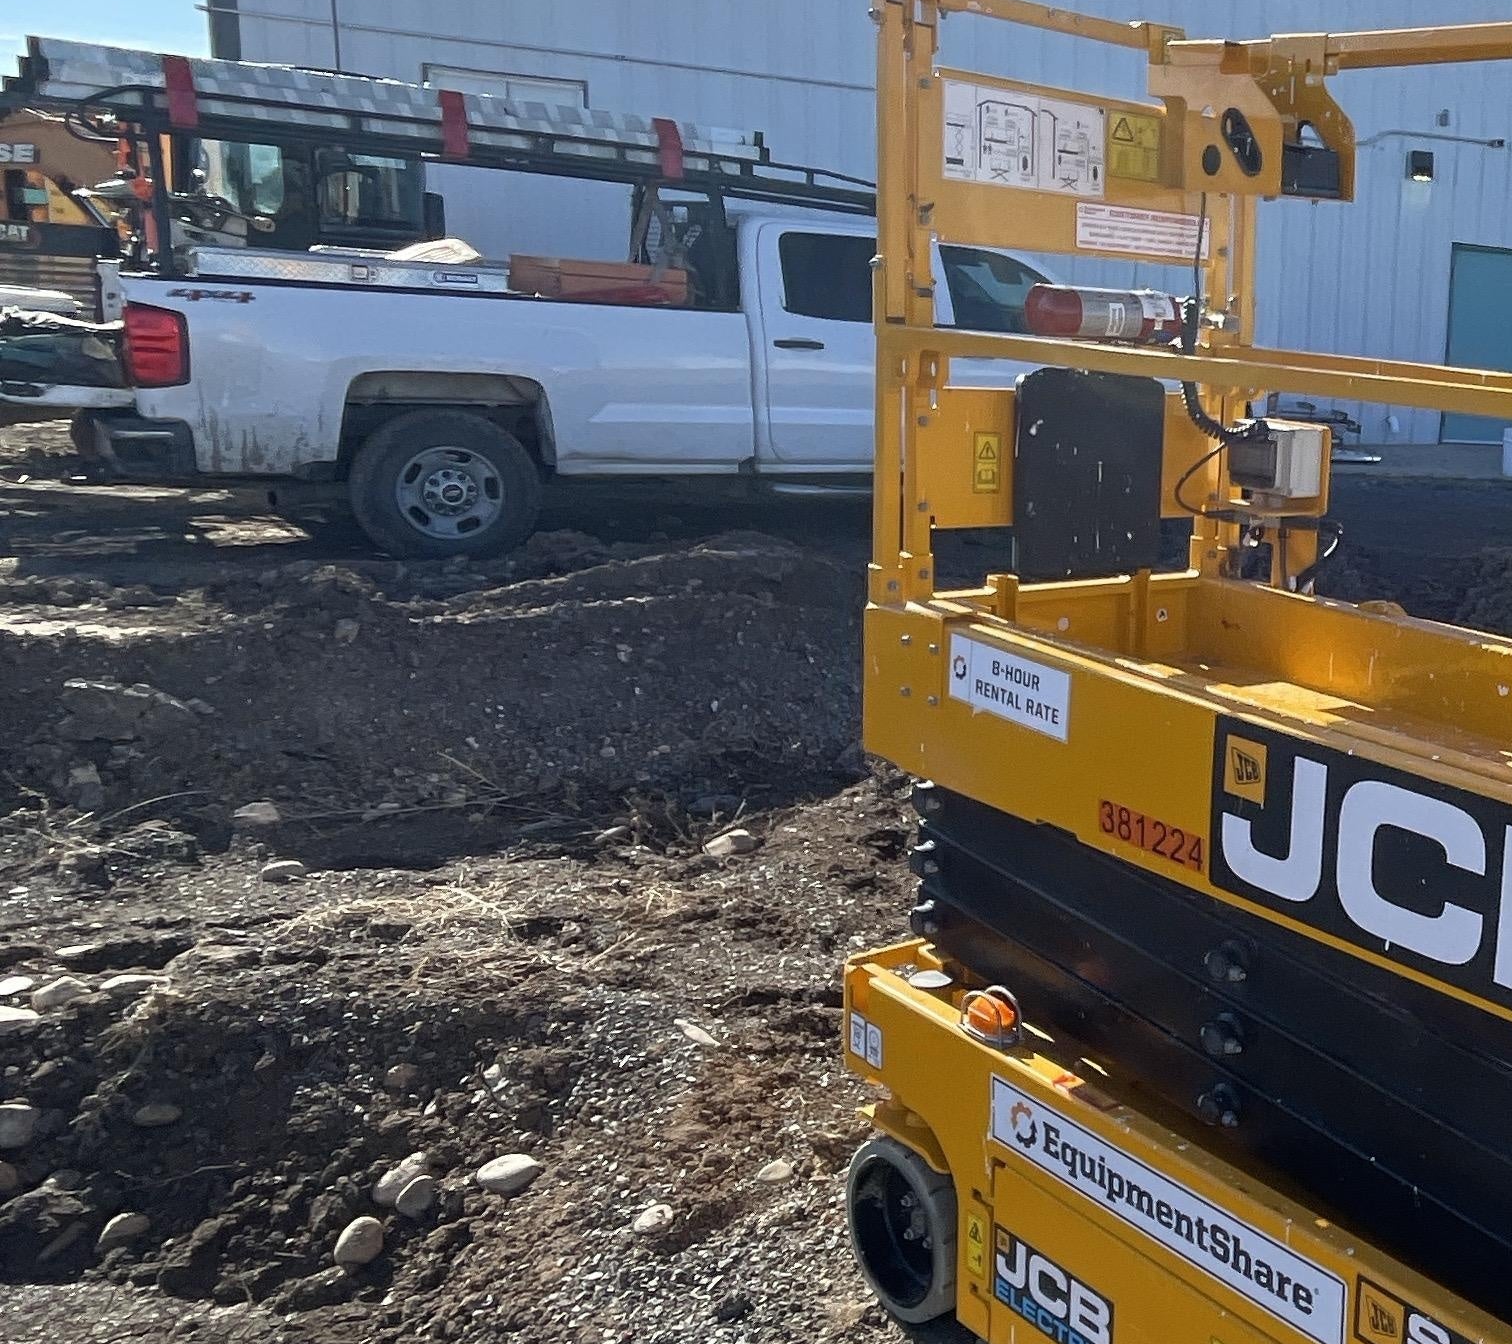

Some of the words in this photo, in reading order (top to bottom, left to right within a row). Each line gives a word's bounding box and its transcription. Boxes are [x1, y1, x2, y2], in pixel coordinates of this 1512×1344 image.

[975, 678, 1021, 711] RENTAL
[1026, 698, 1060, 725] RATE
[1101, 800, 1205, 871] 381224
[1042, 1120, 1315, 1317] EquipmentShare
